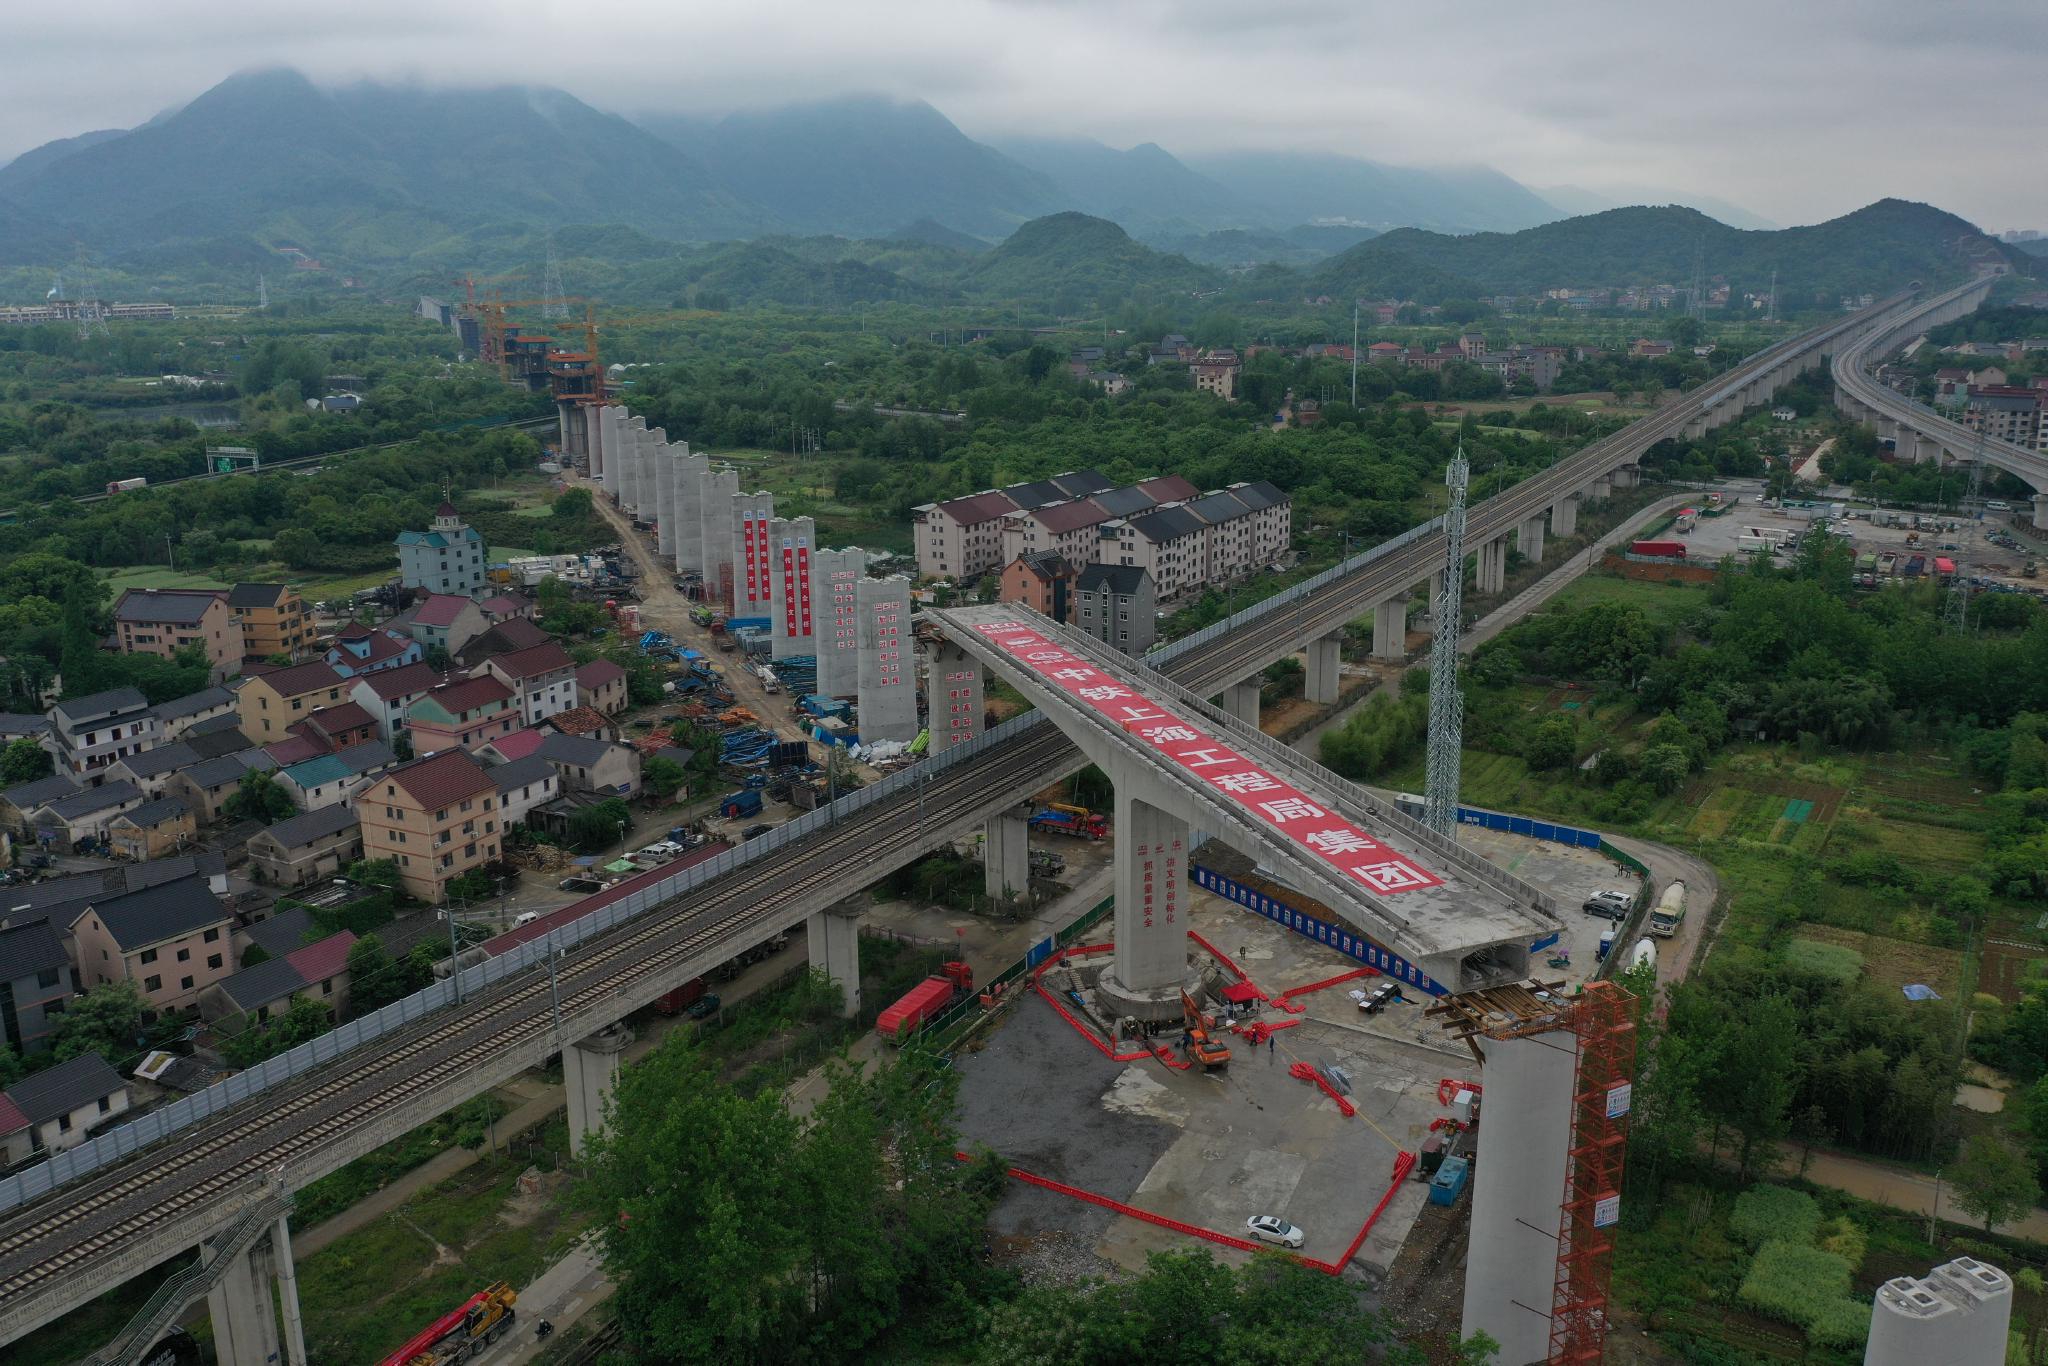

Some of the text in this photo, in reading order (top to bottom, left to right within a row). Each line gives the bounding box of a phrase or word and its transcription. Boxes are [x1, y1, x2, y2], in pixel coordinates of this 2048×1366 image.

[889, 615, 899, 684] 打造精品工程
[1052, 668, 1433, 891] 中铁上海工程局集团
[1143, 860, 1153, 928] 抓质量重安全
